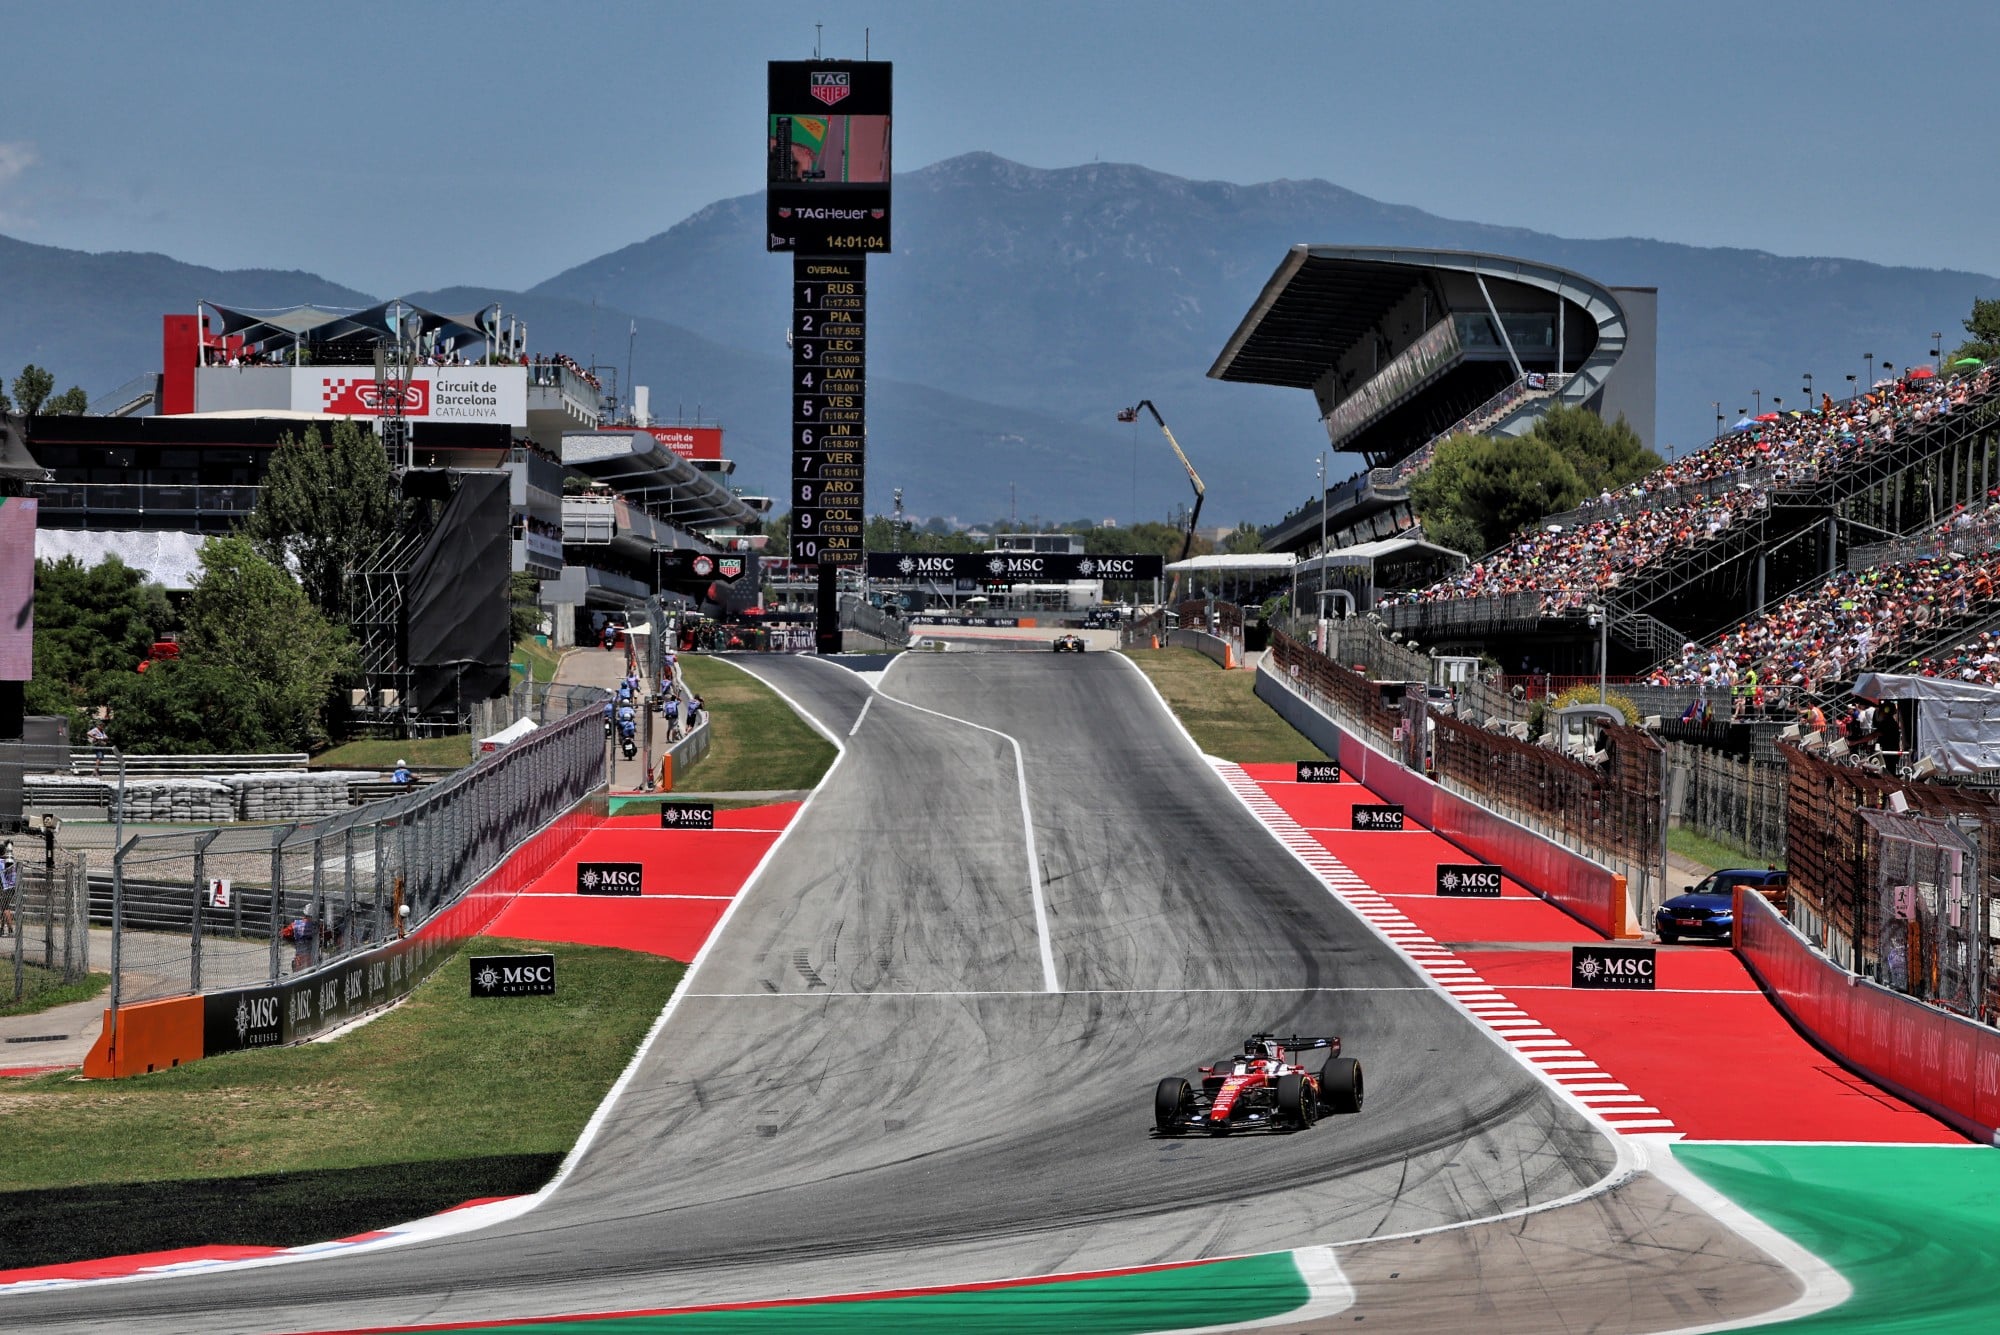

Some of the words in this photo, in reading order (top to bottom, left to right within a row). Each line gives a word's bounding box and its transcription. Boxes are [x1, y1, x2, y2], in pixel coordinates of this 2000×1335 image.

[814, 74, 847, 85] TAG
[813, 87, 848, 103] HEUER
[826, 236, 884, 248] 14:01:04
[807, 266, 850, 274] OVERALL
[803, 288, 811, 303] 1
[827, 284, 854, 294] RUS
[802, 316, 813, 331] 2
[830, 312, 851, 322] PIA
[803, 344, 813, 359] 3
[828, 340, 853, 350] LEC
[436, 381, 479, 392] Circuit
[481, 381, 497, 392] de
[802, 372, 813, 388] 4
[826, 369, 855, 378] LAW
[436, 394, 497, 405] Barcelona
[802, 400, 813, 416] 5
[828, 396, 853, 407] VES
[435, 407, 497, 417] CATALUNYA
[655, 433, 683, 441] Circuit
[683, 433, 694, 442] de
[802, 429, 813, 444] 6
[830, 425, 850, 435] LIN
[801, 457, 812, 472] 7
[826, 453, 853, 463] VER
[802, 485, 812, 501] 8
[824, 481, 854, 492] ARO
[801, 513, 812, 528] 9
[825, 510, 852, 520] COL
[796, 541, 817, 557] 10
[828, 537, 849, 548] SAI
[917, 558, 954, 571] MSC
[1008, 558, 1044, 571] MSC
[1097, 560, 1134, 572] MSC
[1313, 767, 1339, 777] MSC
[681, 810, 712, 820] MSC
[1371, 812, 1402, 823] MSC
[601, 871, 640, 885] MSC
[1461, 873, 1499, 887] MSC
[503, 966, 551, 983] MSC
[1604, 958, 1653, 976] MSC
[350, 969, 363, 999] MSC
[325, 979, 339, 1010] MSC
[250, 996, 278, 1028] MSC
[296, 989, 312, 1021] MSC
[249, 1032, 278, 1043] CRUISES
